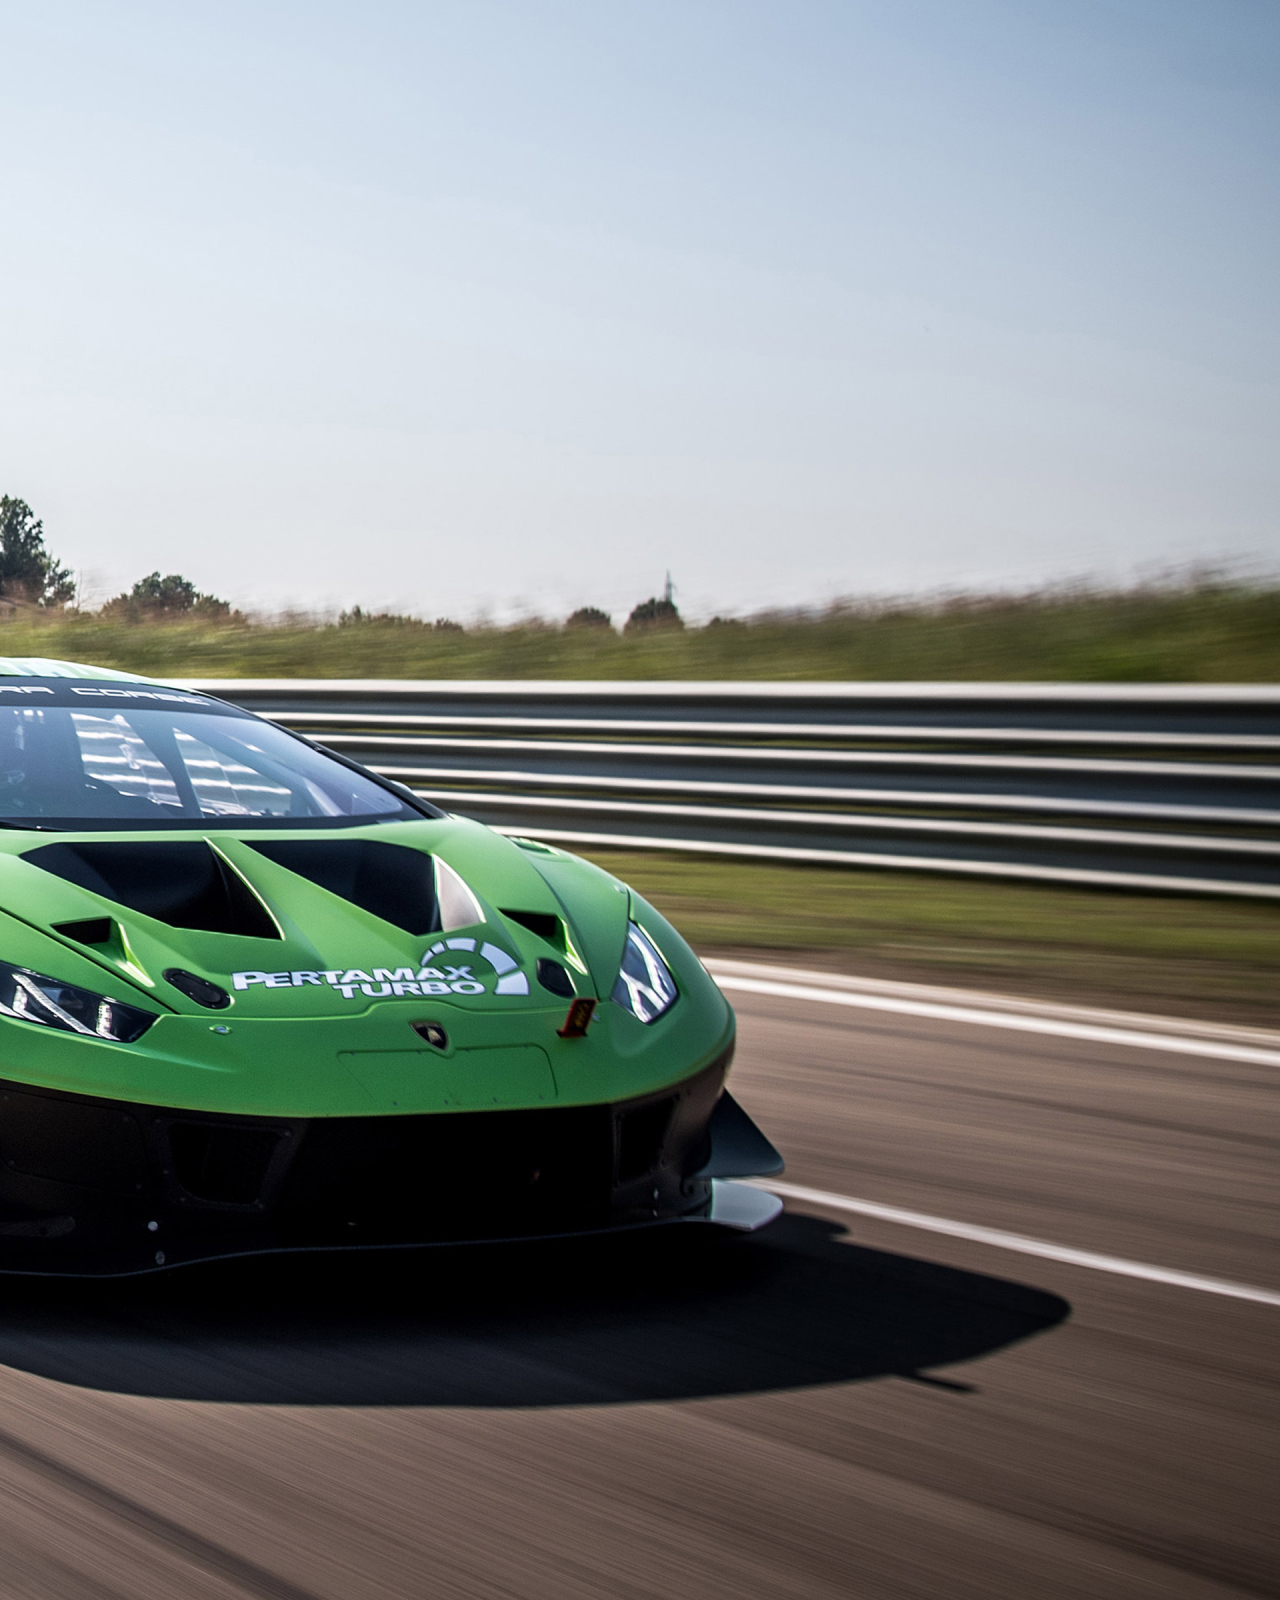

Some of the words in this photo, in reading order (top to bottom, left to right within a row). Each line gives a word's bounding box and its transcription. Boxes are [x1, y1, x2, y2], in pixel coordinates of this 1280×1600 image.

[71, 687, 211, 706] CORSE
[231, 965, 477, 991] PERTAMAX
[332, 981, 487, 999] TURBO
